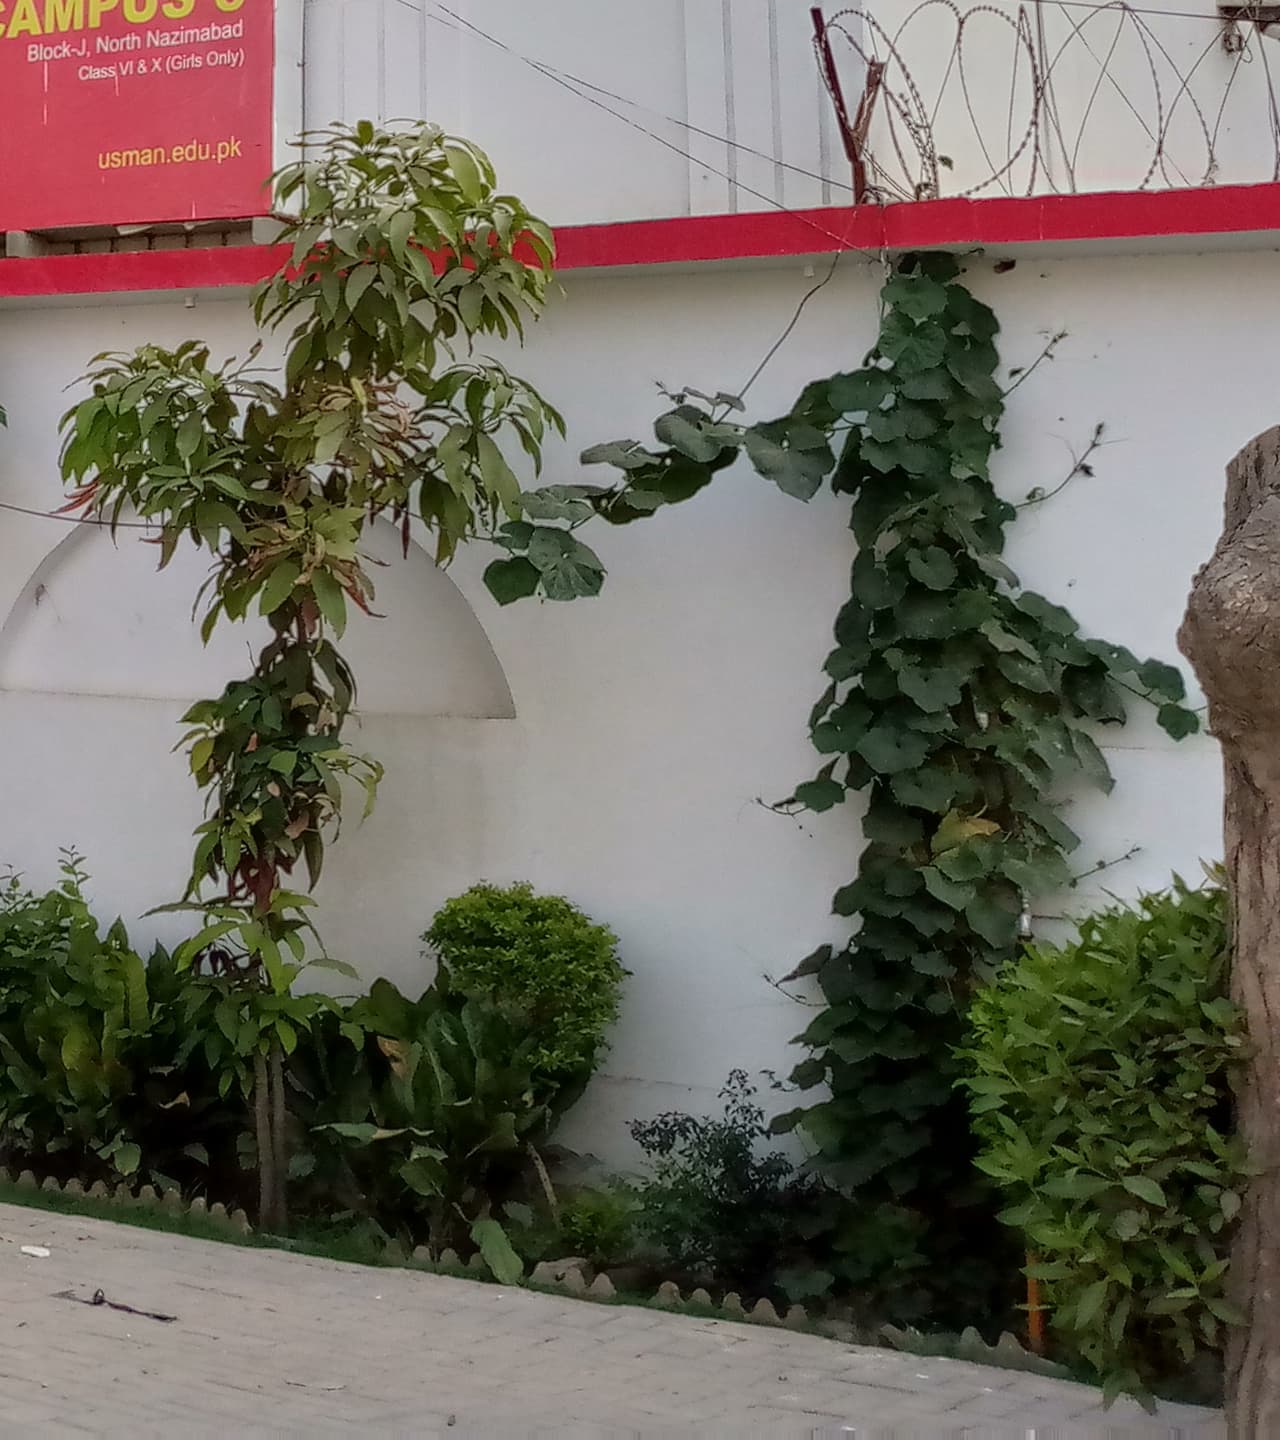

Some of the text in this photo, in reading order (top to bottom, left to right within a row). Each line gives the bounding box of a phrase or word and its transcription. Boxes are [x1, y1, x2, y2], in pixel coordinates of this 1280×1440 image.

[27, 19, 244, 63] Block-J, North Nazimabad
[78, 48, 244, 81] Class VI & X (Girls Only)
[98, 135, 242, 169] usman.edu.pk
